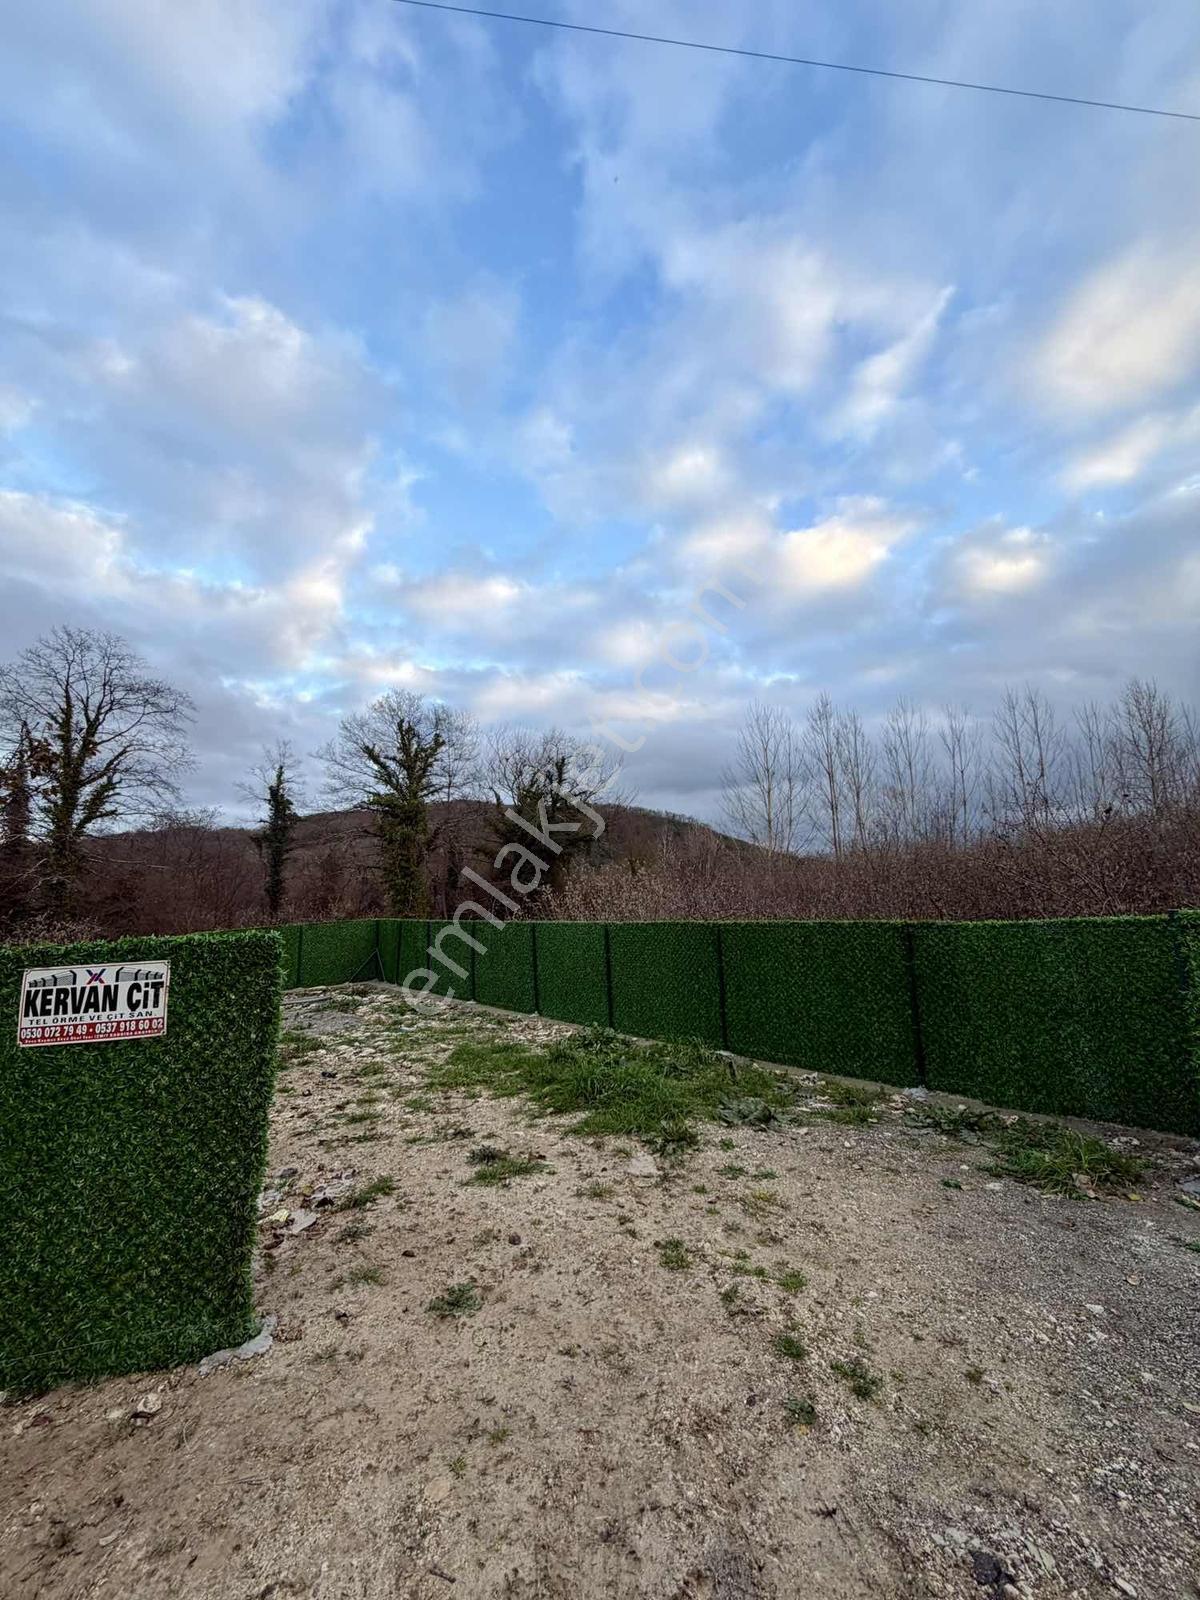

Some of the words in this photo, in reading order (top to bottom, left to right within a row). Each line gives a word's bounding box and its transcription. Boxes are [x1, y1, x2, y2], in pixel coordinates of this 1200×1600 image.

[23, 984, 119, 1018] KERVAN
[20, 1027, 42, 1039] 0530
[44, 1026, 61, 1038] 072
[63, 1025, 74, 1037] 79
[76, 1024, 87, 1035] 49
[95, 1022, 118, 1034] 0537
[119, 1020, 136, 1032] 918
[138, 1019, 150, 1030] 60
[151, 1018, 164, 1029] 02
[29, 1018, 48, 1026] TEL
